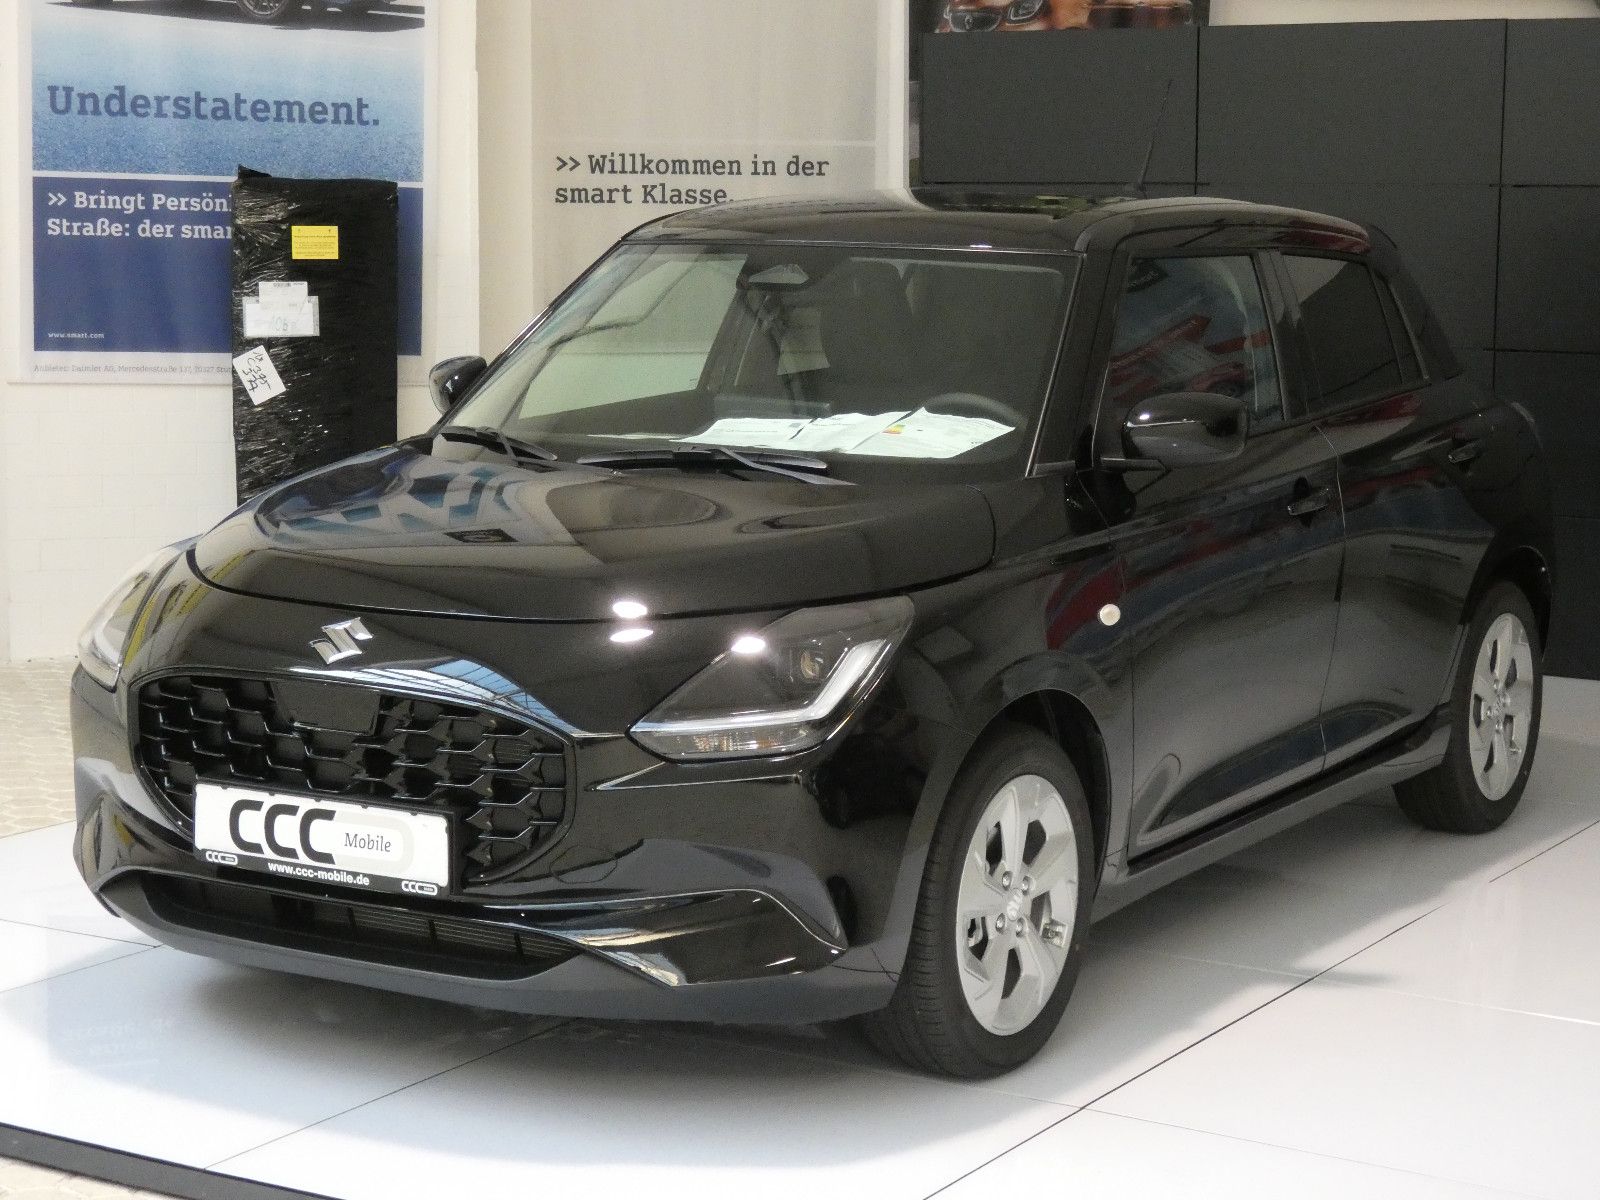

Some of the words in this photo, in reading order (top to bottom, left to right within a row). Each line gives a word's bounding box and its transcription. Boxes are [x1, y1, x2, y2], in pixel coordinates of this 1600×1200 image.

[47, 85, 380, 126] Understatement.
[588, 152, 742, 176] Willkommen
[751, 154, 776, 176] in
[786, 155, 829, 177] der
[74, 190, 145, 214] Bringt
[555, 183, 632, 204] smart
[47, 217, 130, 237] Straße:
[137, 219, 174, 238] der
[48, 332, 105, 340] www.smart.com
[229, 799, 336, 865] CCC
[344, 833, 392, 852] Mobile
[268, 862, 370, 886] www.ccc-mobile.de
